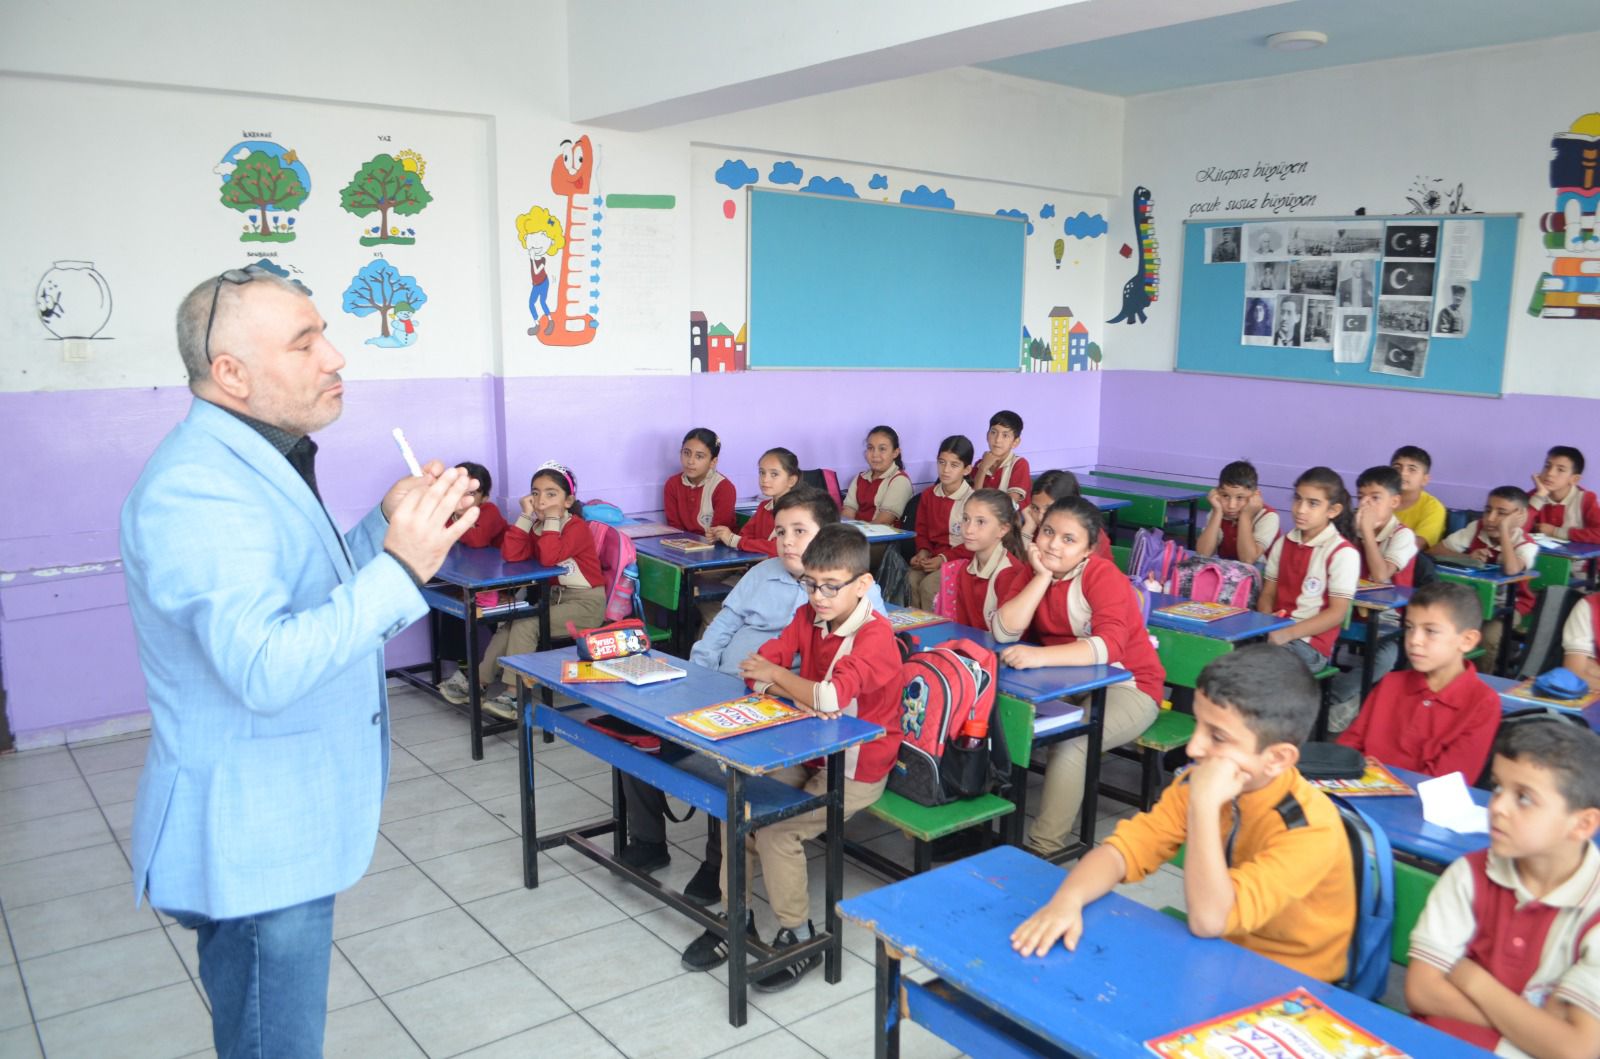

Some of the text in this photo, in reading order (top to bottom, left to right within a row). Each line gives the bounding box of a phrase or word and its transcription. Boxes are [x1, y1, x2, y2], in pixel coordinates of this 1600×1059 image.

[1188, 197, 1221, 218] çocuk
[1225, 198, 1258, 210] susuz
[594, 637, 615, 647] WHO
[595, 645, 616, 656] ME?
